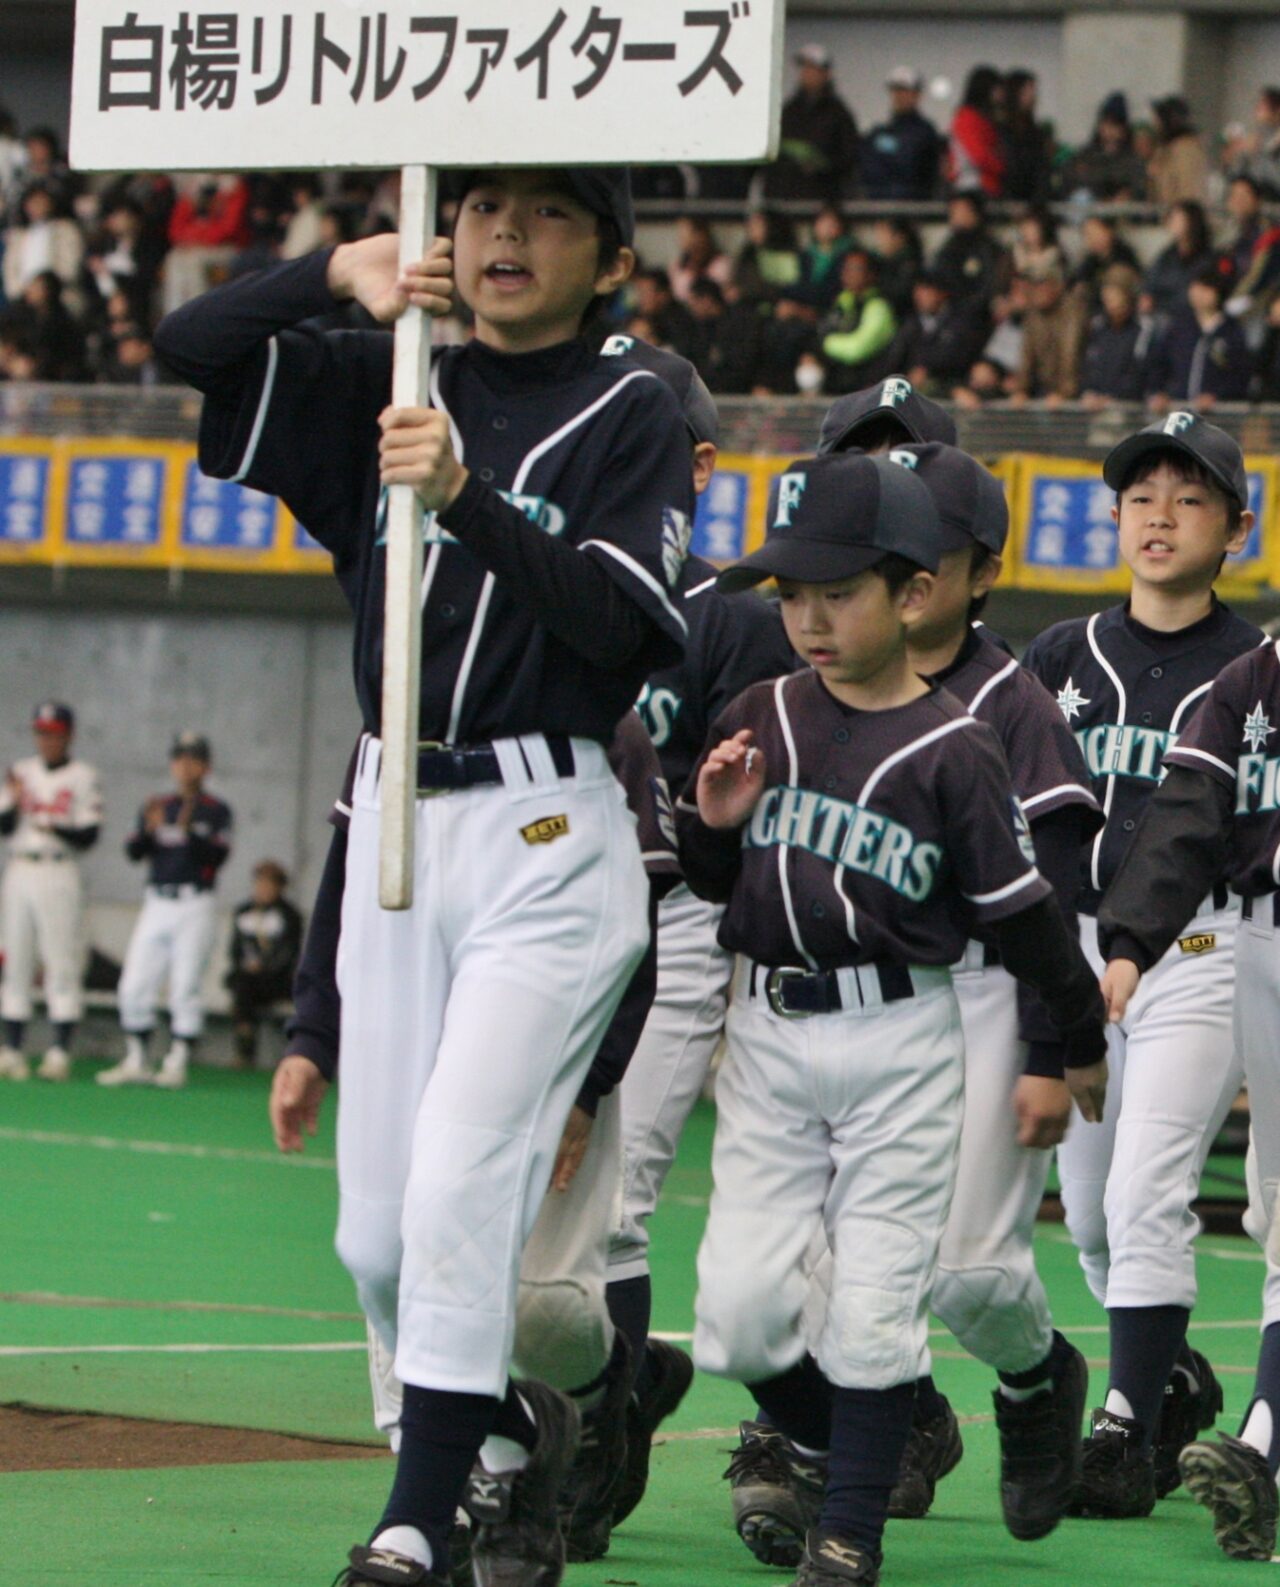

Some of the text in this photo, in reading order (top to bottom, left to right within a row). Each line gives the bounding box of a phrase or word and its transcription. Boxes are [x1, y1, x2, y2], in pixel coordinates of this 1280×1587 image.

[98, 1, 751, 112] 白楊リトルファイターズ
[877, 377, 912, 408] F
[773, 472, 806, 528] F
[742, 785, 943, 902] GHTERS
